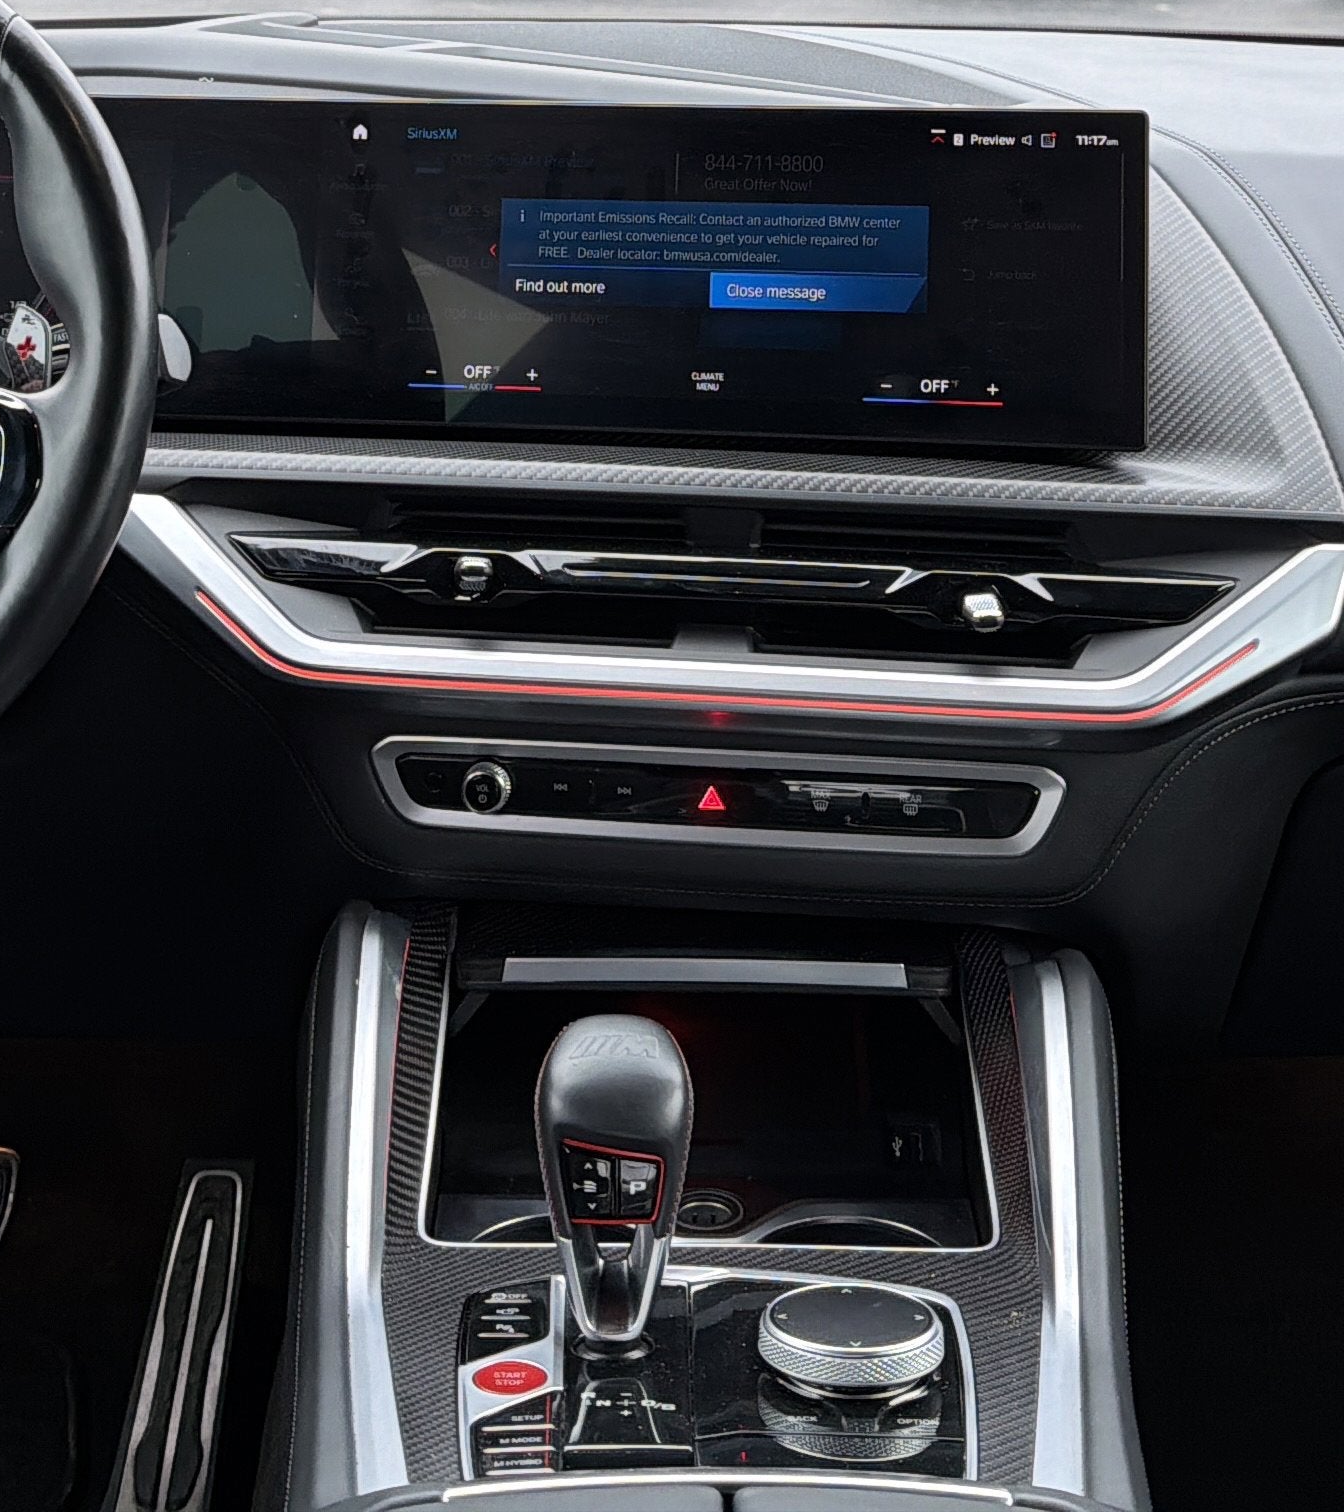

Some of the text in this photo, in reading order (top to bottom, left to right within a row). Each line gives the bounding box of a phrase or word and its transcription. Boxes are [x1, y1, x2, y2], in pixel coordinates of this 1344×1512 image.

[407, 128, 458, 140] SiriusXM
[970, 134, 1016, 146] Preview
[705, 154, 824, 173] 844-711-8800
[540, 210, 595, 224] Important
[598, 212, 656, 225] Emissions
[658, 212, 697, 225] Recall:
[699, 213, 744, 226] Contact
[746, 215, 761, 226] an
[763, 214, 826, 228] authorized
[828, 216, 860, 228] BMW
[863, 218, 901, 229] center
[538, 230, 879, 249] at your earliest convenience to get your vehicle repaired for
[577, 247, 615, 260] Dealer
[617, 248, 660, 261] locator:
[663, 249, 781, 264] bmwusa.com/dealer.
[515, 279, 606, 294] Find out more
[726, 283, 826, 301] Close message
[464, 365, 492, 378] OFF
[691, 372, 724, 382] CLIMATE
[696, 382, 720, 392] MENU
[920, 379, 950, 393] OFF
[899, 792, 922, 803] REAR
[629, 1181, 646, 1195] P
[494, 1371, 527, 1379] START
[495, 1378, 525, 1386] STOP
[511, 1414, 544, 1423] SETUP
[512, 1436, 543, 1444] MODE
[506, 1458, 543, 1467] HYBRID
